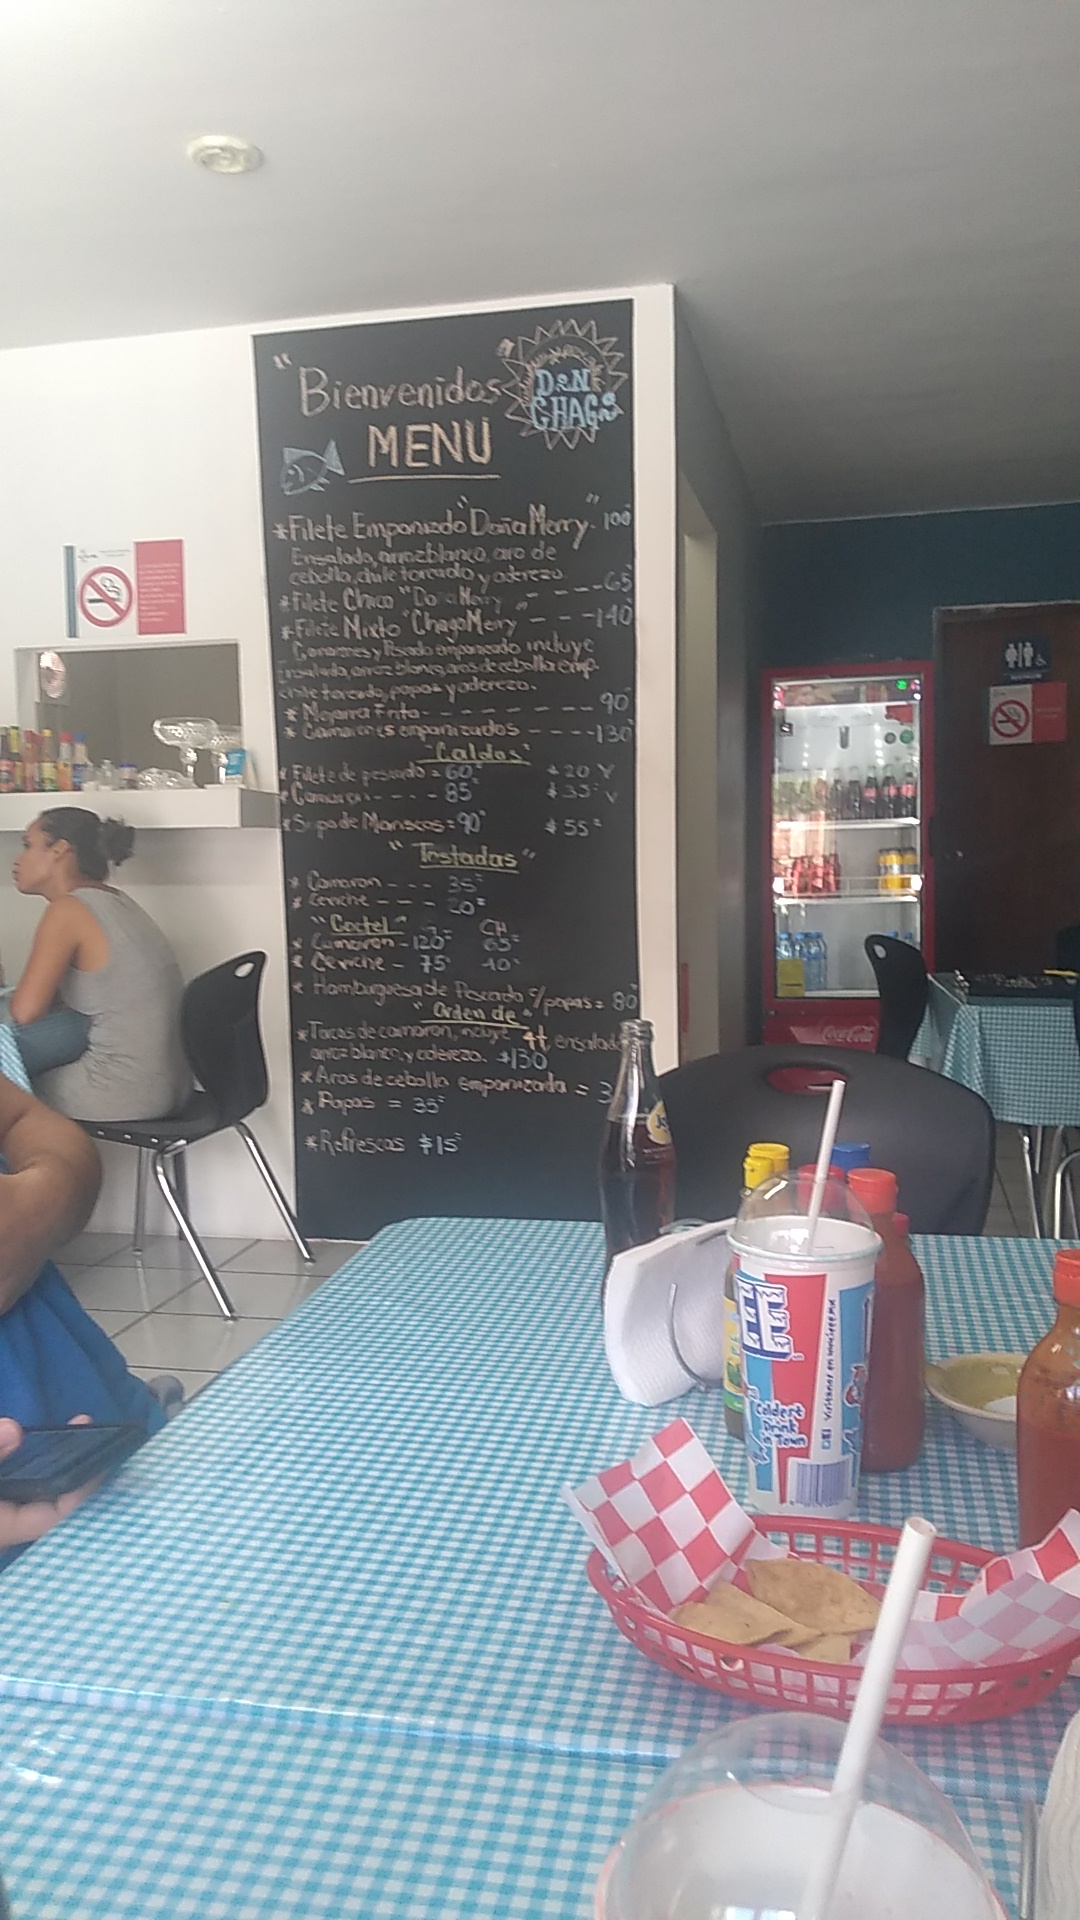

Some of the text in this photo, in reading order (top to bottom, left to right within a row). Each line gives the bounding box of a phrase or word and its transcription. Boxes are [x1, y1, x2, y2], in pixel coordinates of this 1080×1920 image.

[530, 540, 558, 562] de
[360, 1067, 384, 1088] de
[762, 1419, 798, 1435] Drink
[774, 1434, 807, 1447] Town
